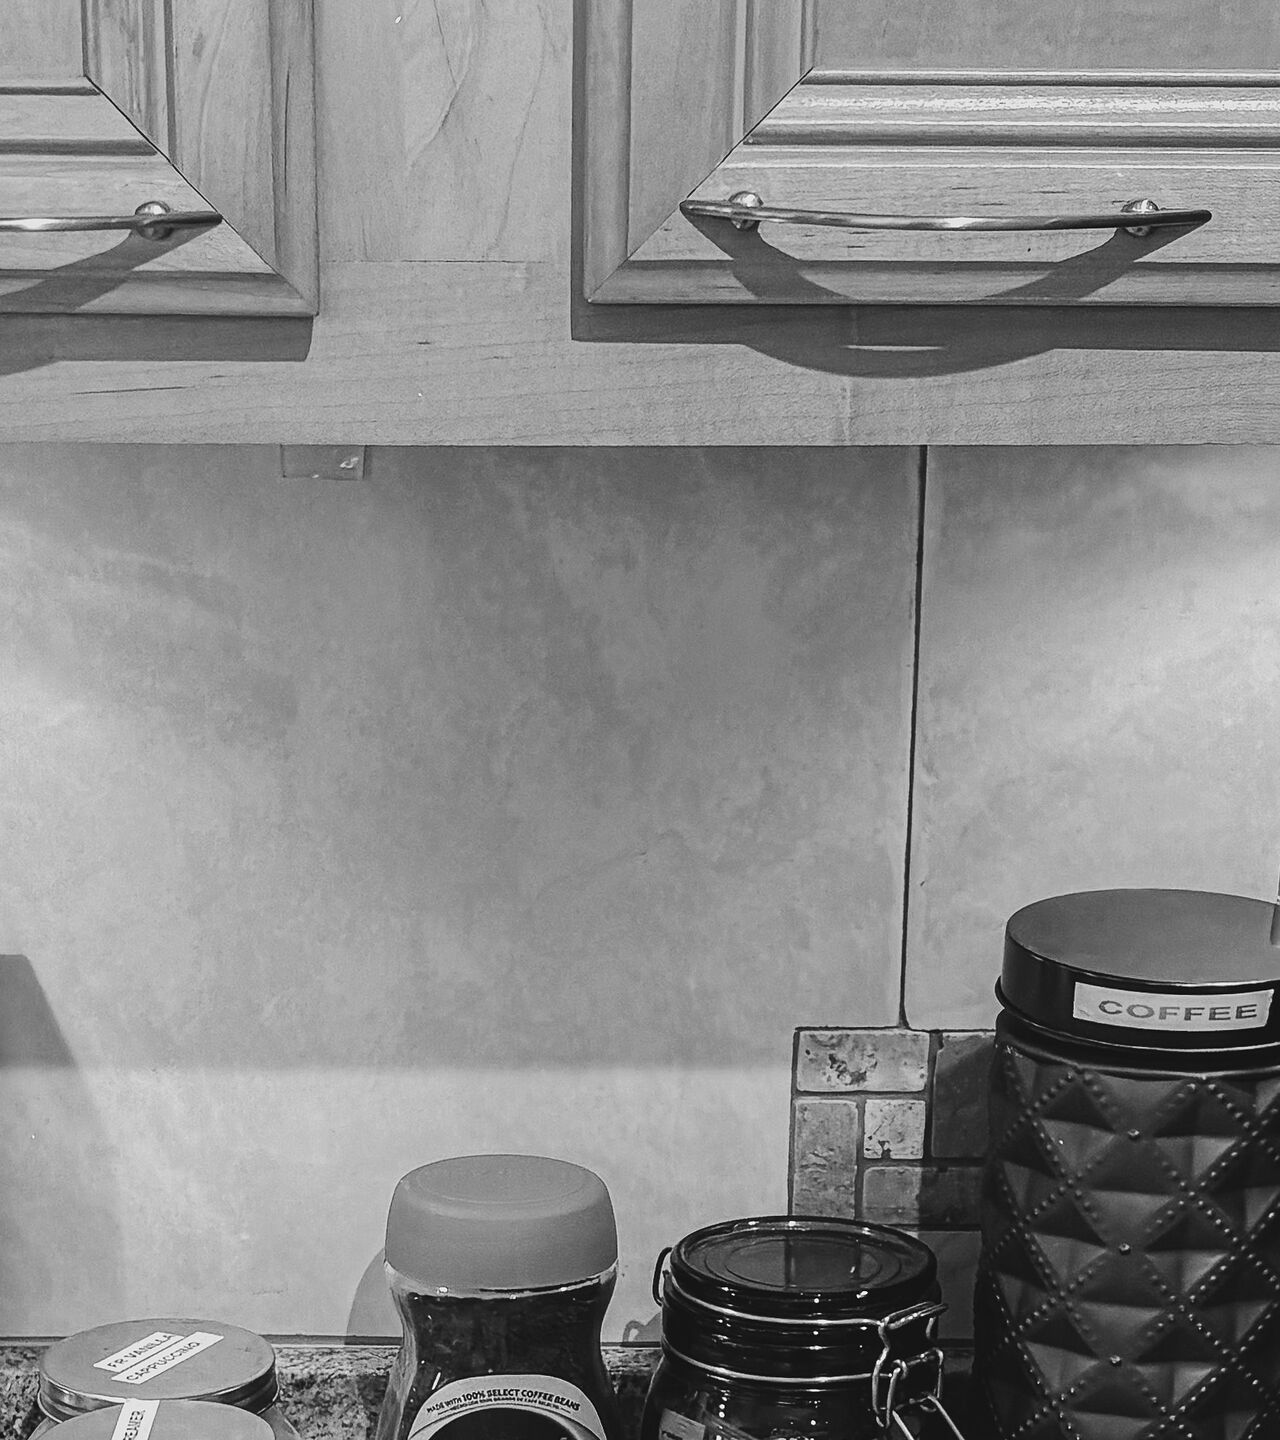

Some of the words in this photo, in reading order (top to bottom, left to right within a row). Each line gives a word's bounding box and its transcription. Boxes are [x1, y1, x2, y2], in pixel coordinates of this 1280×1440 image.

[1098, 1000, 1258, 1021] COFFEE
[124, 1334, 173, 1358] VANILLA
[426, 1402, 445, 1414] MADE
[445, 1397, 462, 1408] WITH
[462, 1391, 485, 1402] 100%
[487, 1388, 520, 1398] SELECT
[521, 1389, 554, 1401] COFFEE
[554, 1395, 581, 1411] BEANS
